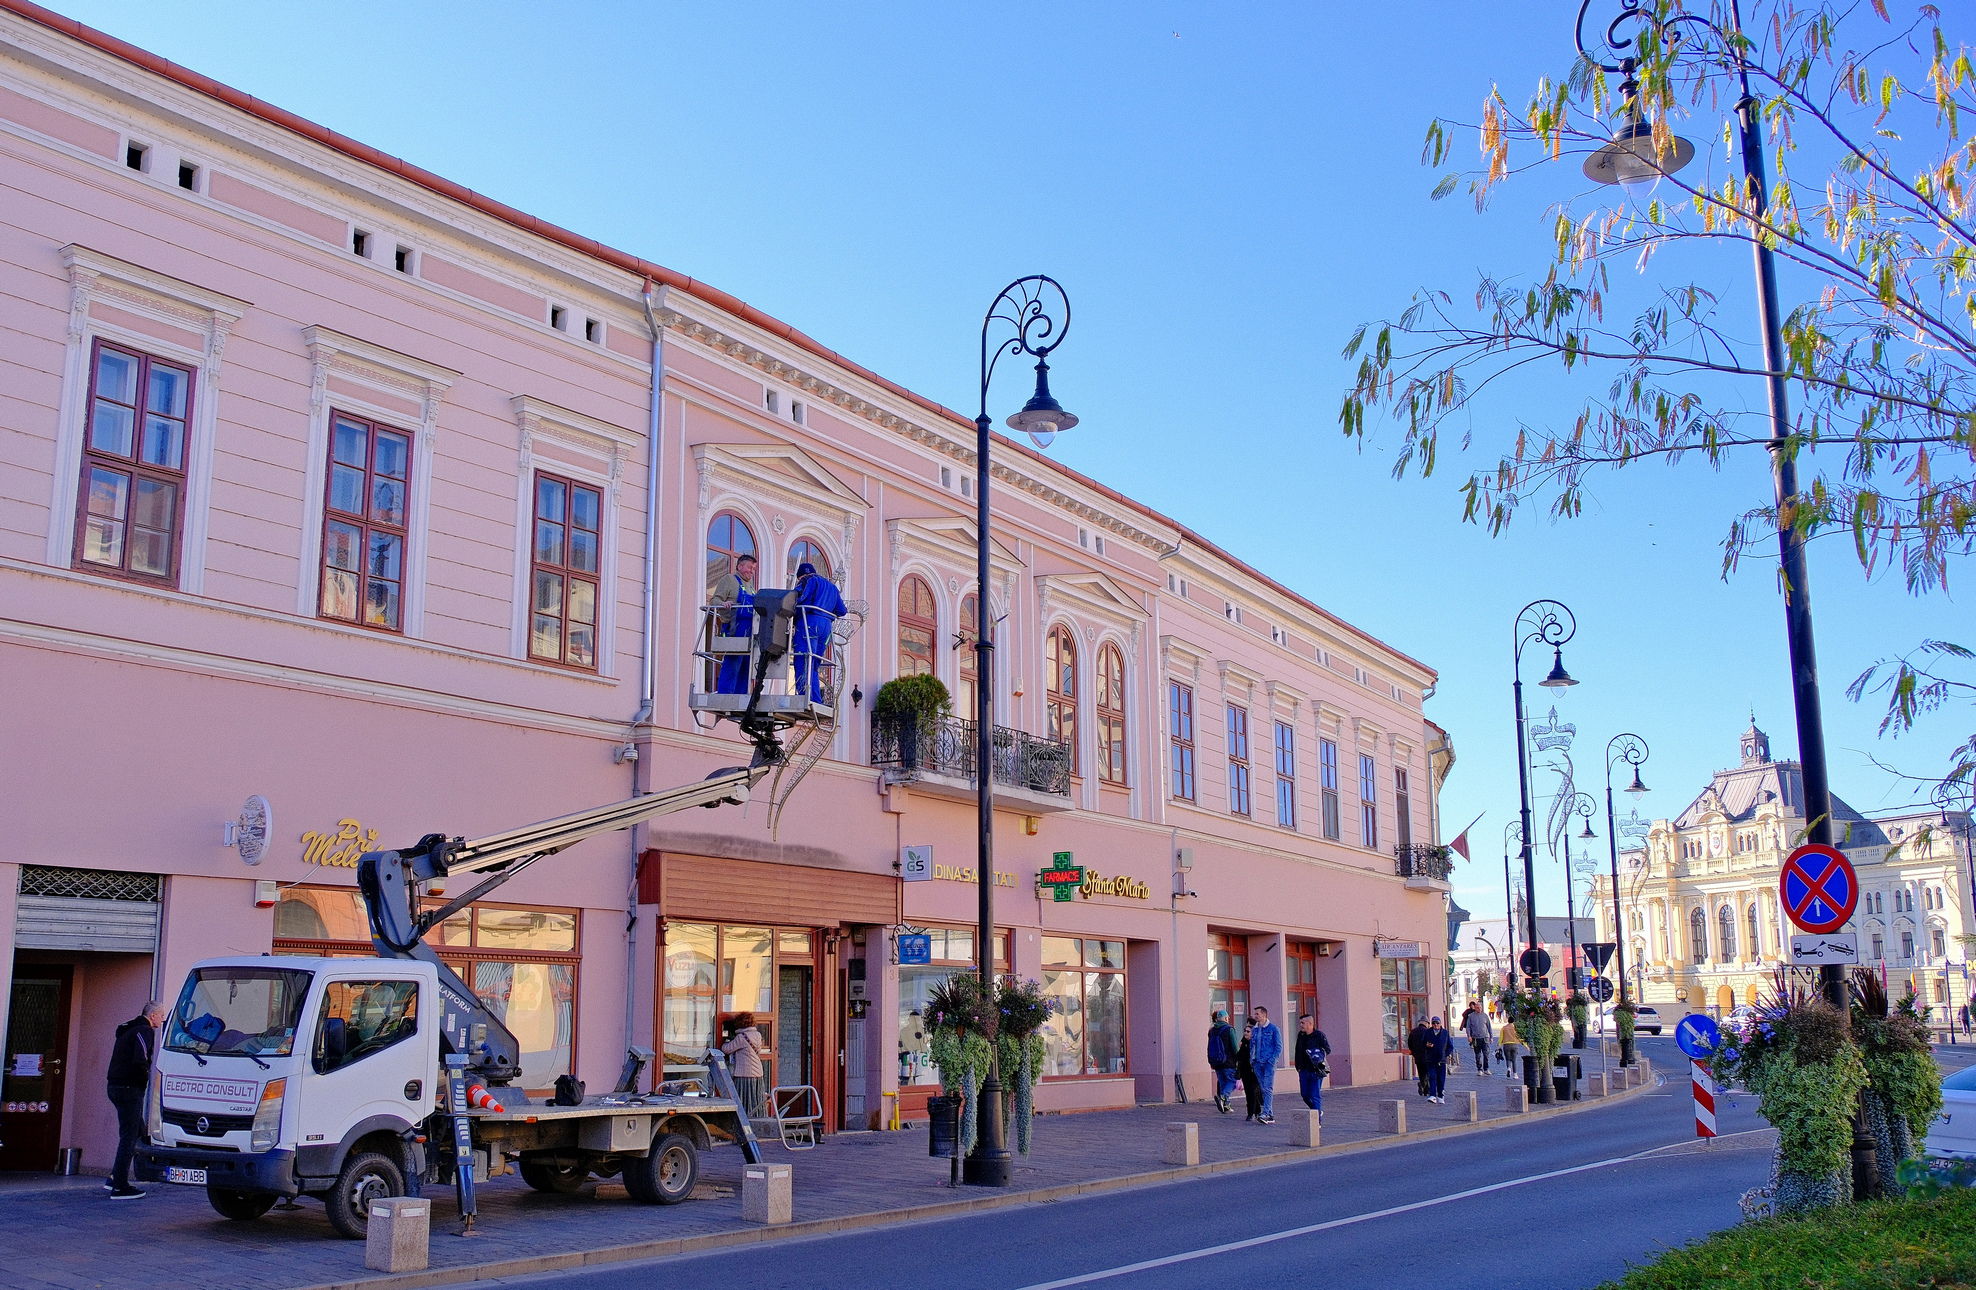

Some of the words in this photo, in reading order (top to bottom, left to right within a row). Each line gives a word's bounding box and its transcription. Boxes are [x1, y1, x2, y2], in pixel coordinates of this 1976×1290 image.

[906, 860, 925, 872] GS
[166, 1081, 204, 1094] ELECTRO
[206, 1084, 254, 1098] CONSULT
